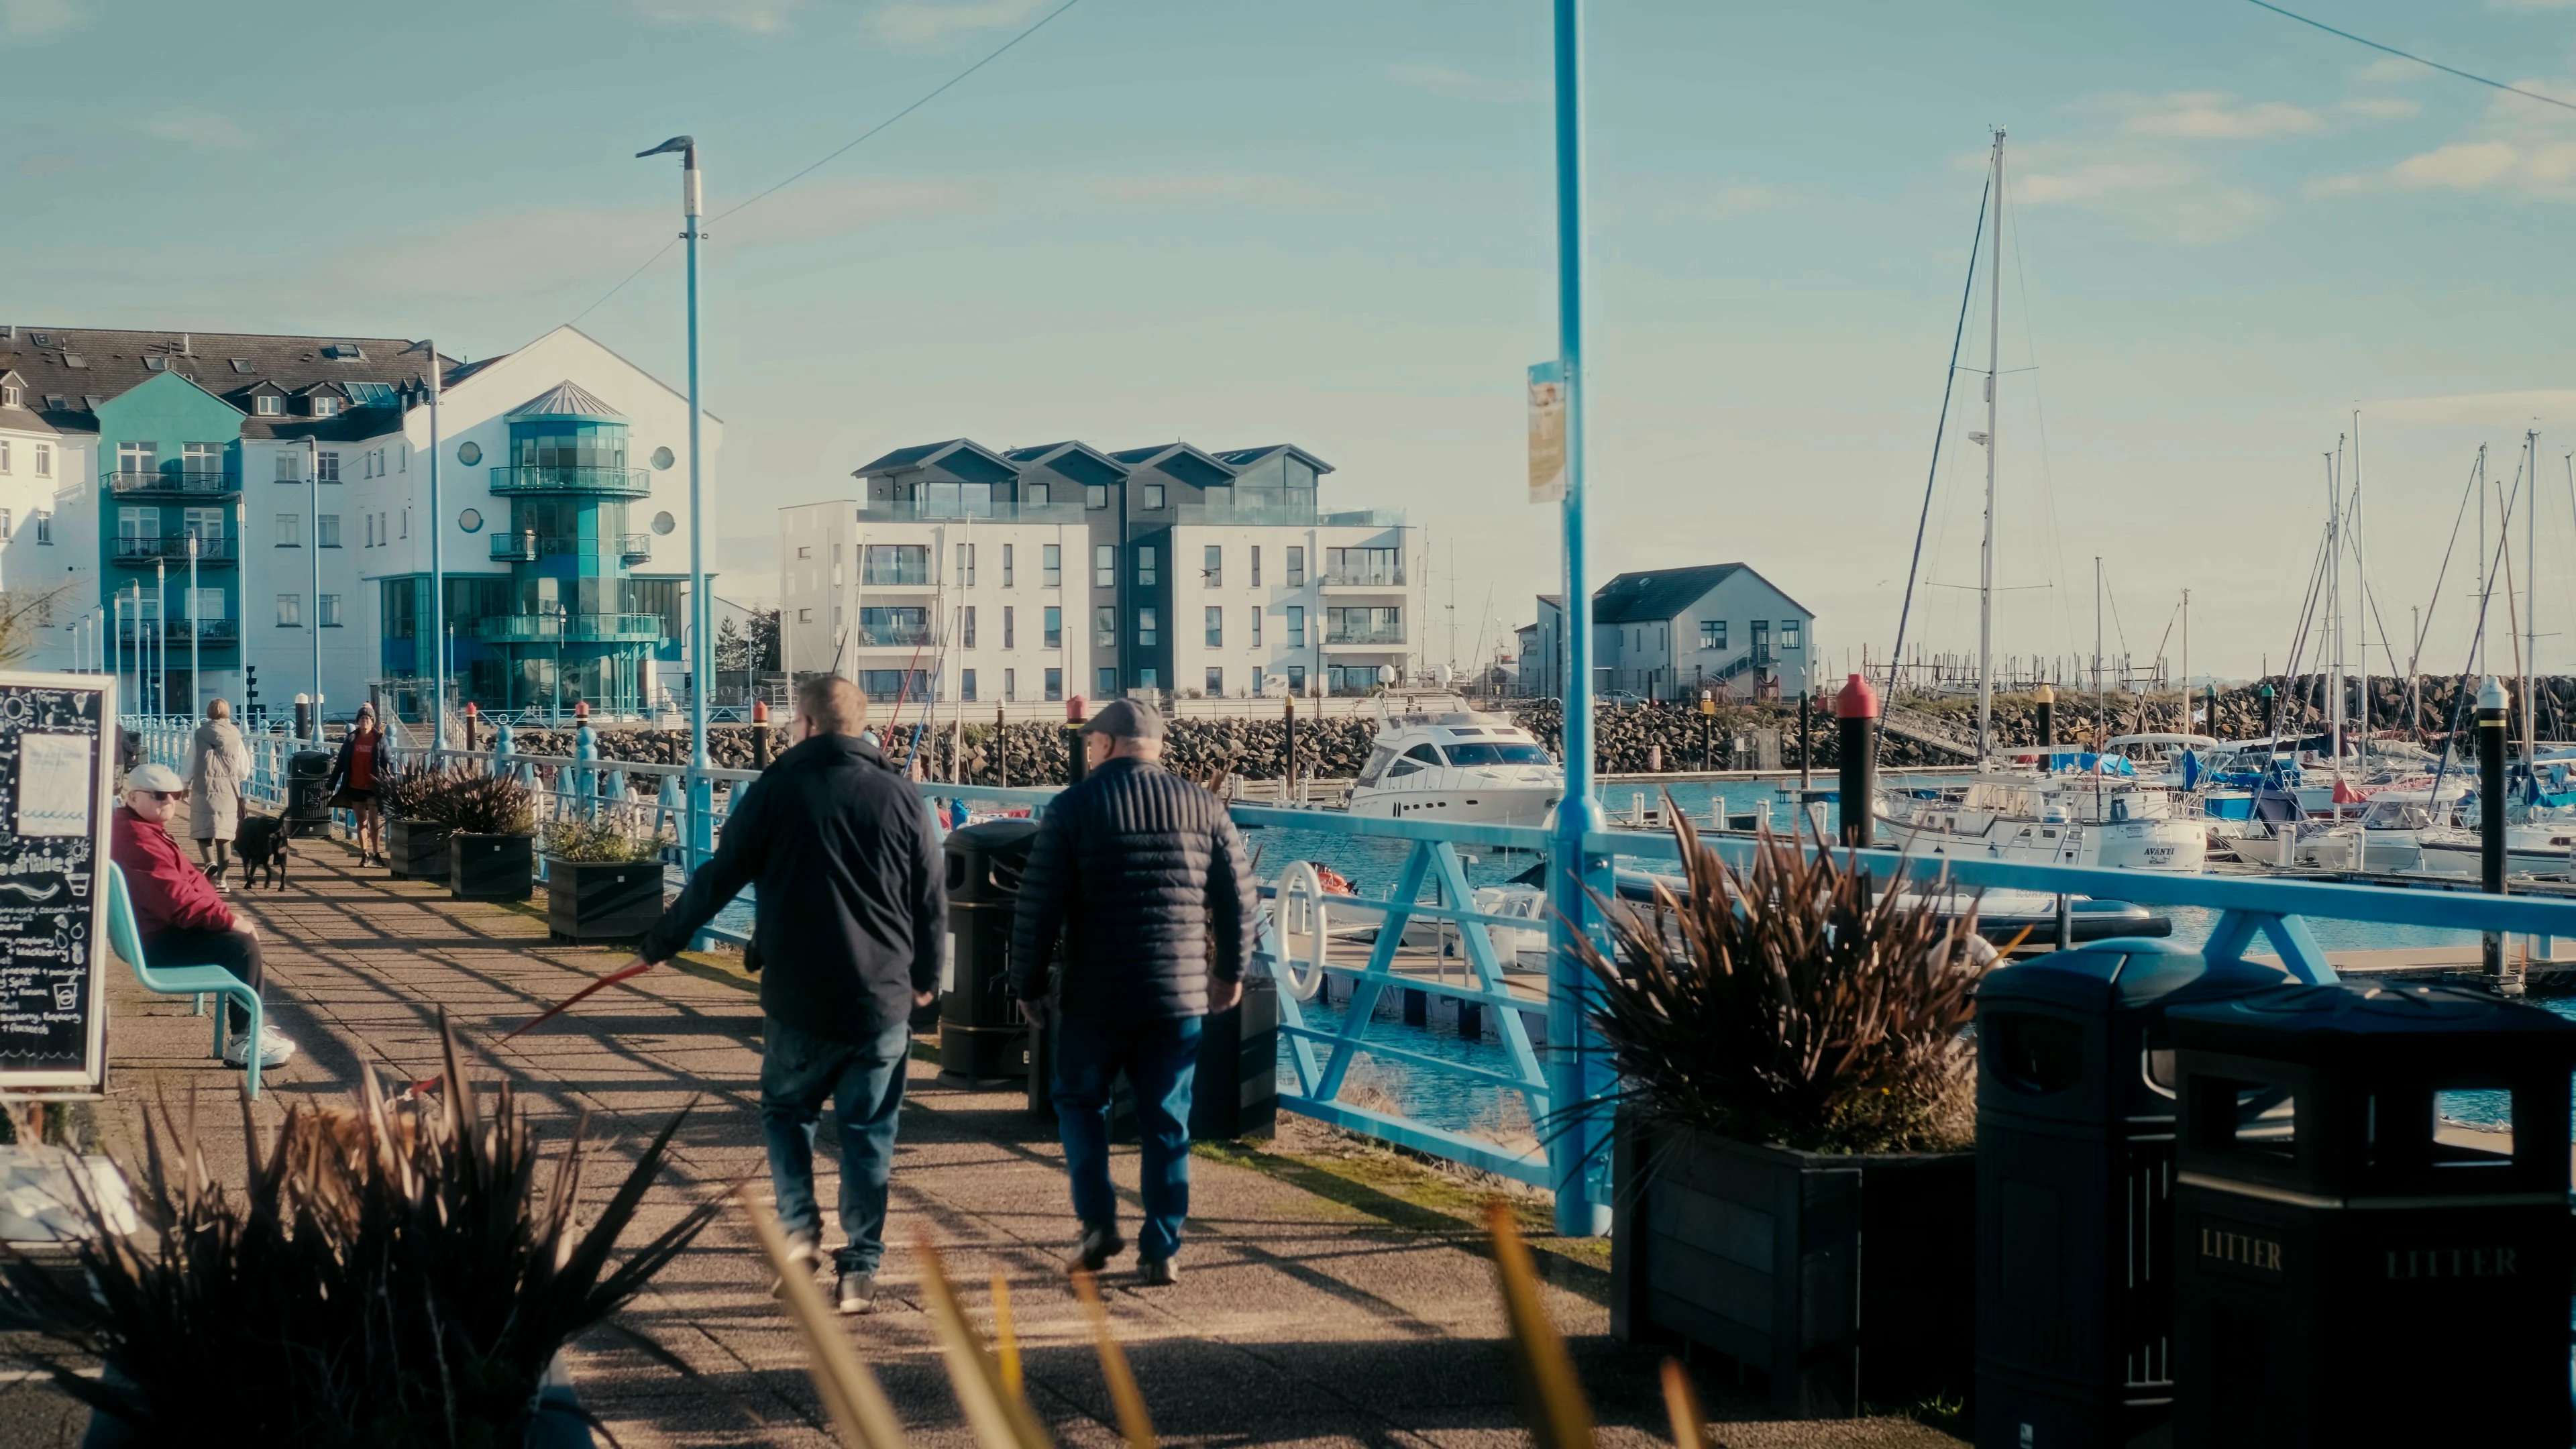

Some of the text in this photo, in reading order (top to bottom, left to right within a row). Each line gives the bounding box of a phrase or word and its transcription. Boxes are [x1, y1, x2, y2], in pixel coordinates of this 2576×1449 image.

[2144, 847, 2175, 855] AVANTI
[2202, 1228, 2281, 1271] LITTER
[2386, 1247, 2517, 1279] LITTER
